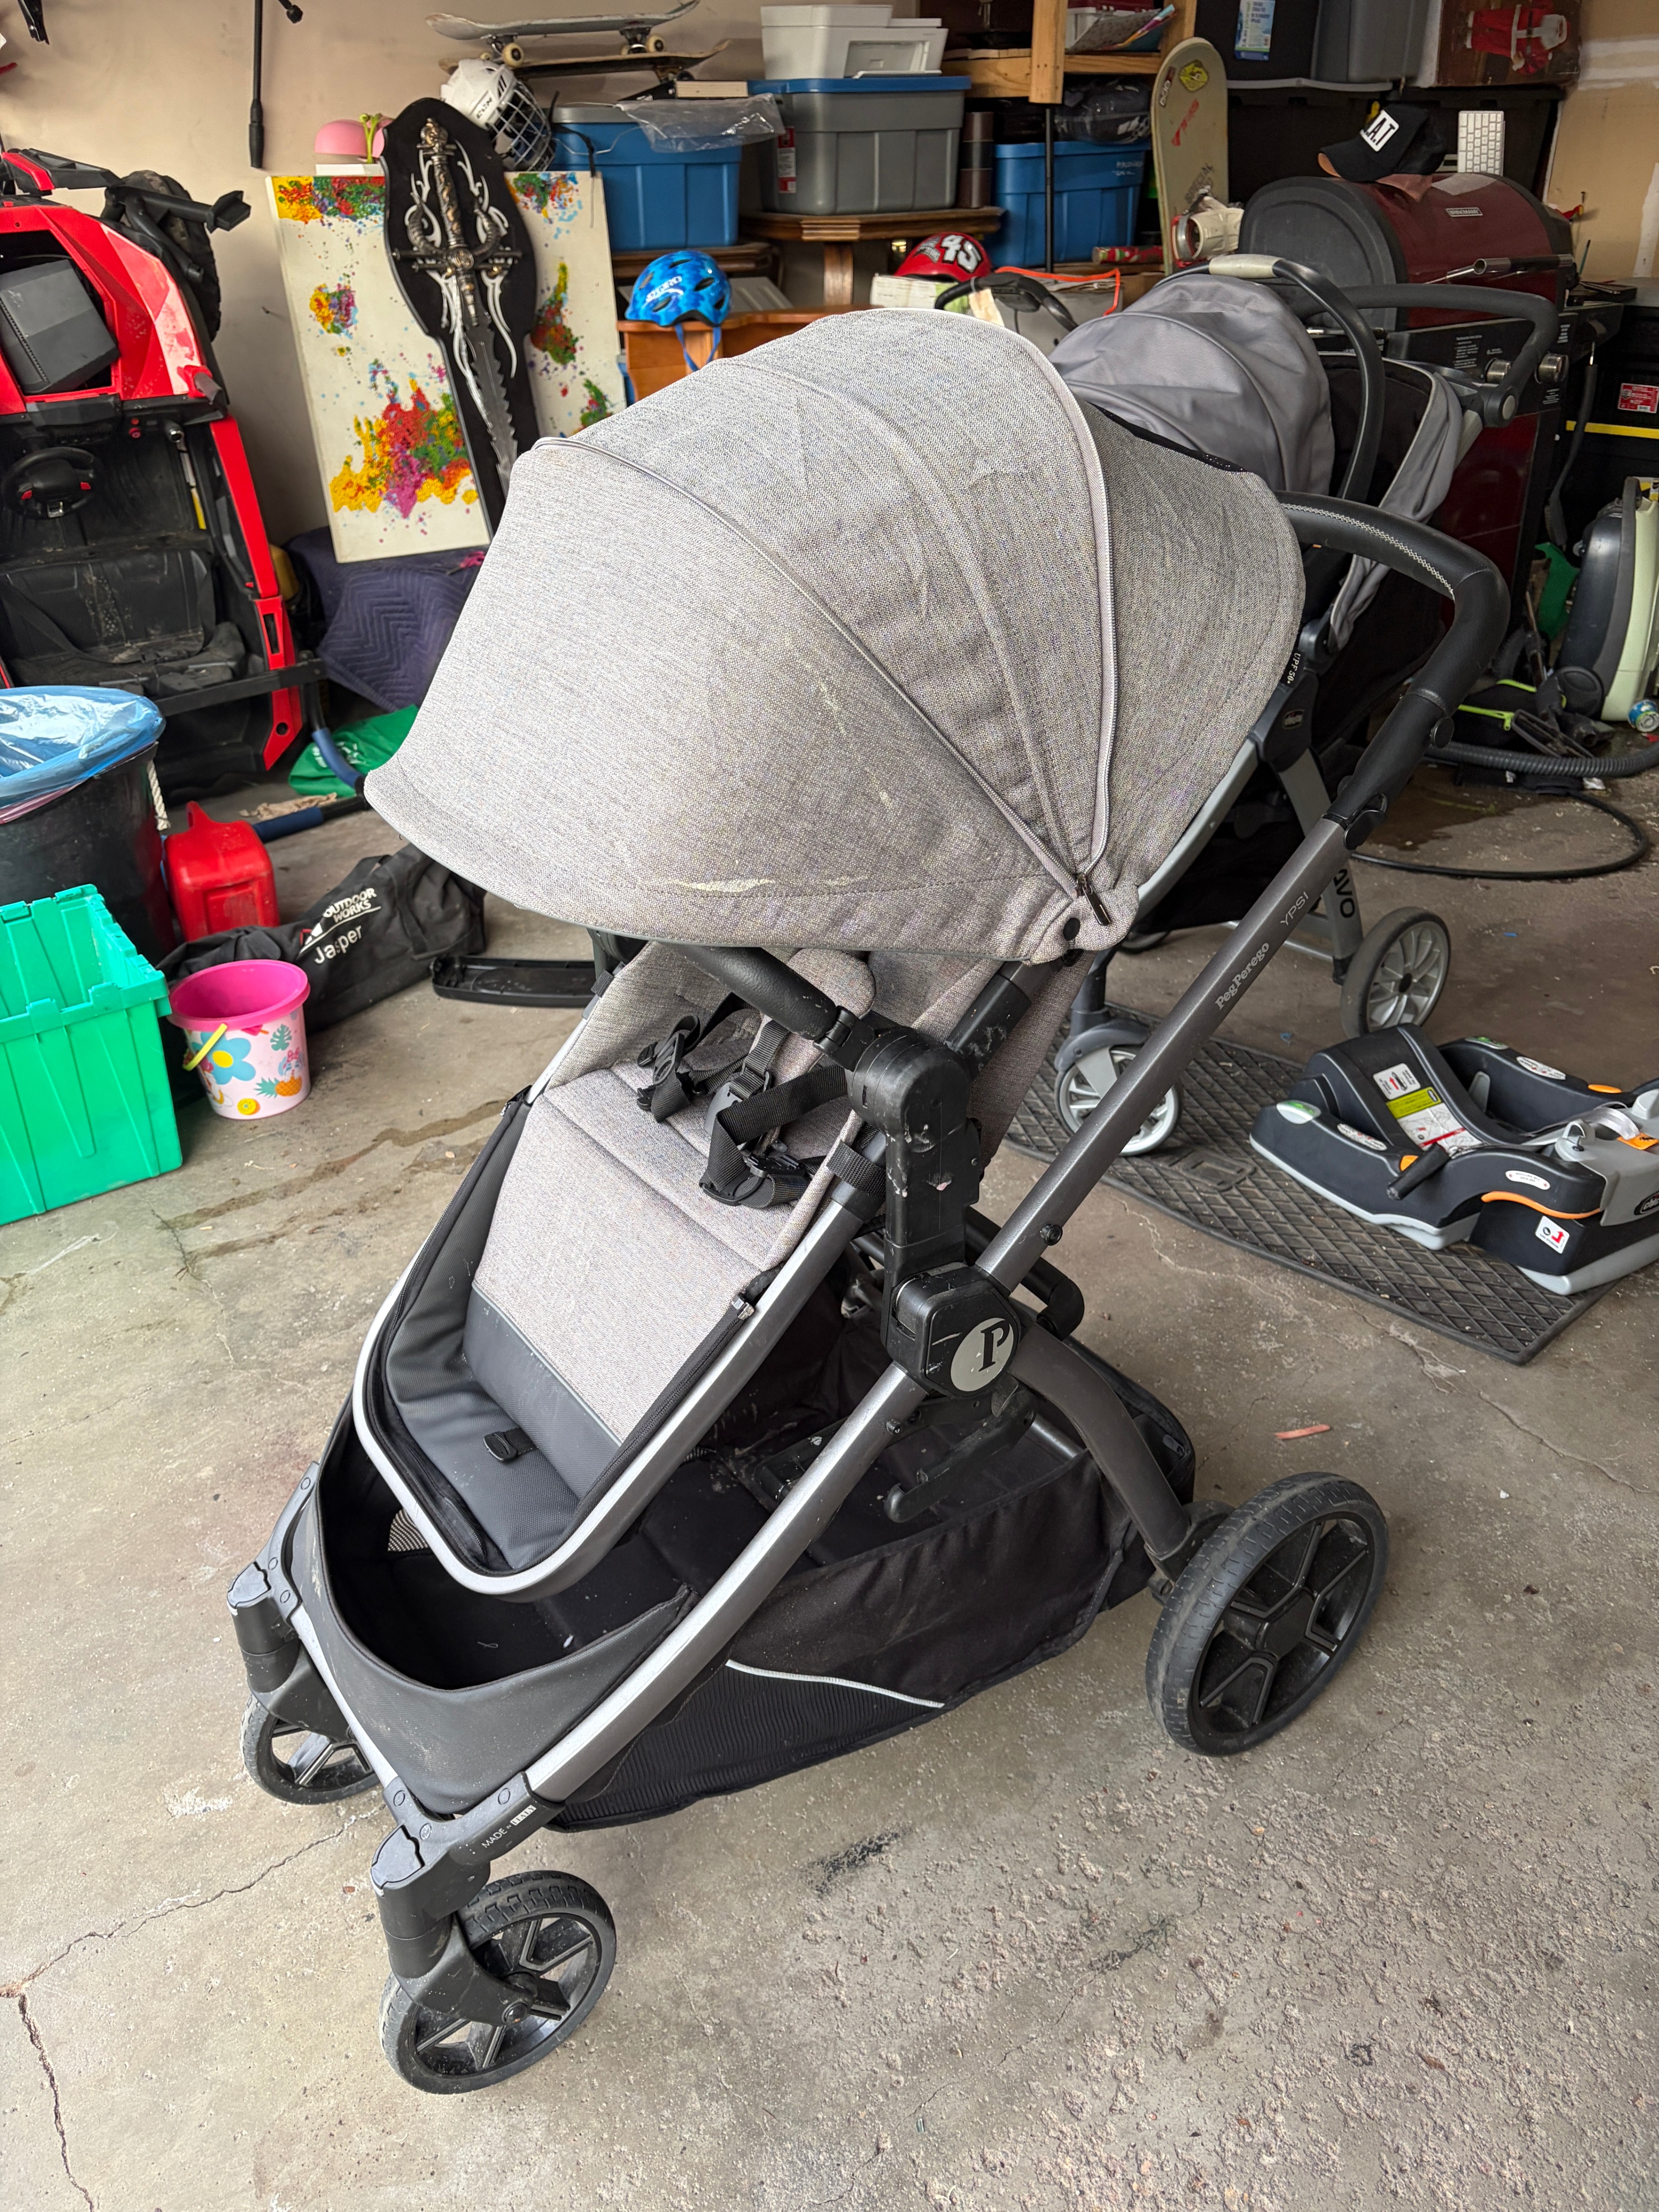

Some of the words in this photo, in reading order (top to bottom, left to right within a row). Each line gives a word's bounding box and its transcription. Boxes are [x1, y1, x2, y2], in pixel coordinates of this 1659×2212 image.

[1291, 652, 1301, 671] UPF
[323, 888, 378, 918] OUTDOOR
[333, 900, 372, 923] WORKS
[314, 925, 362, 960] Jasper
[1214, 942, 1269, 1010] PegPerego
[1280, 891, 1309, 925] YPSI
[978, 1321, 1010, 1372] P
[481, 1827, 507, 1848] MADE
[511, 1806, 535, 1825] ITALY
